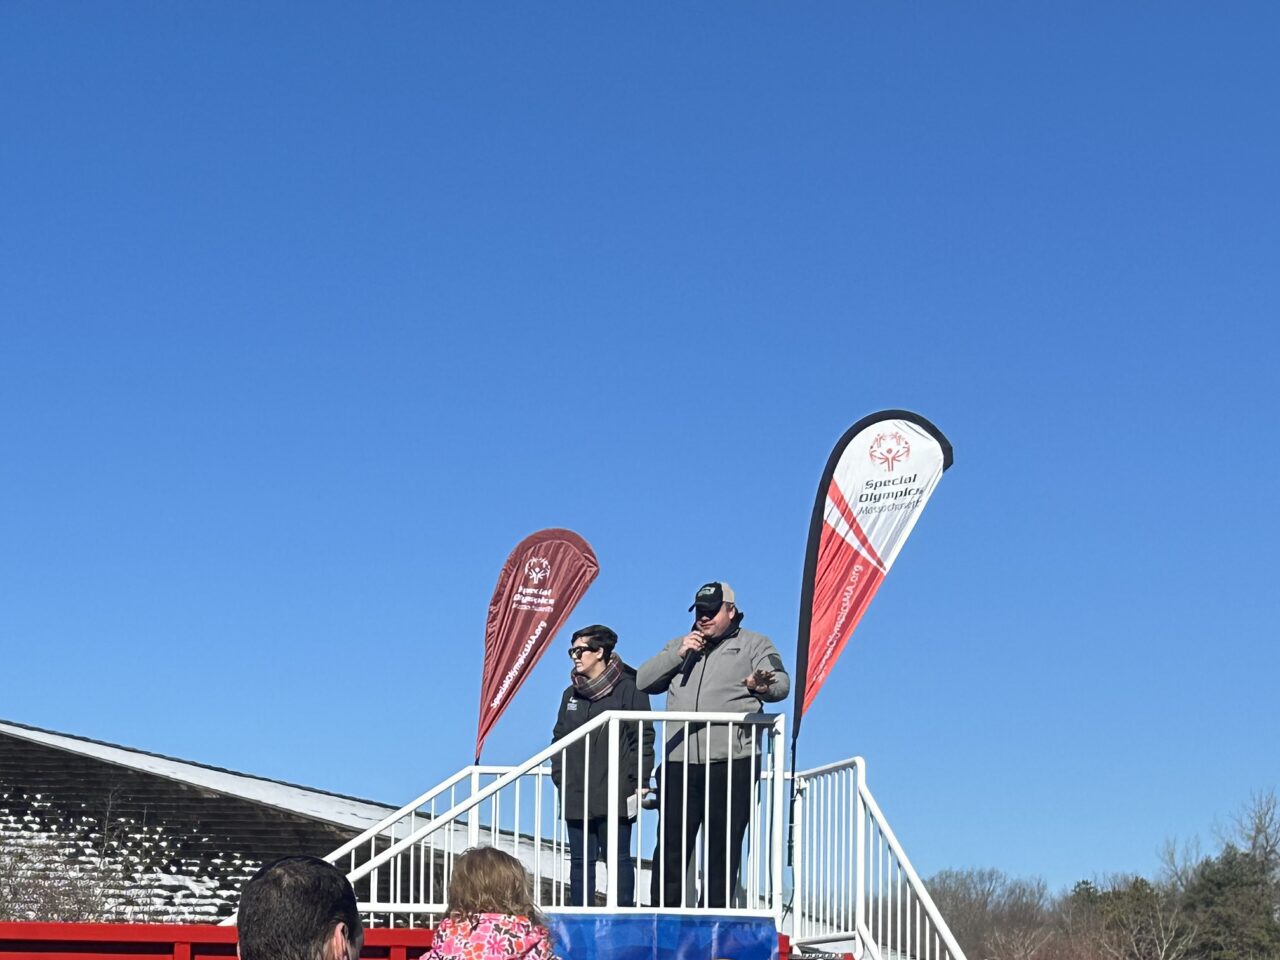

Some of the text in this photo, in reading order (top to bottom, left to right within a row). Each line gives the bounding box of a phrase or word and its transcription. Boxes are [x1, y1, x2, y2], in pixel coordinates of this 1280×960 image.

[865, 474, 917, 490] Special
[859, 487, 923, 503] Olympics
[491, 620, 547, 708] SpecialOlympicsMA.org
